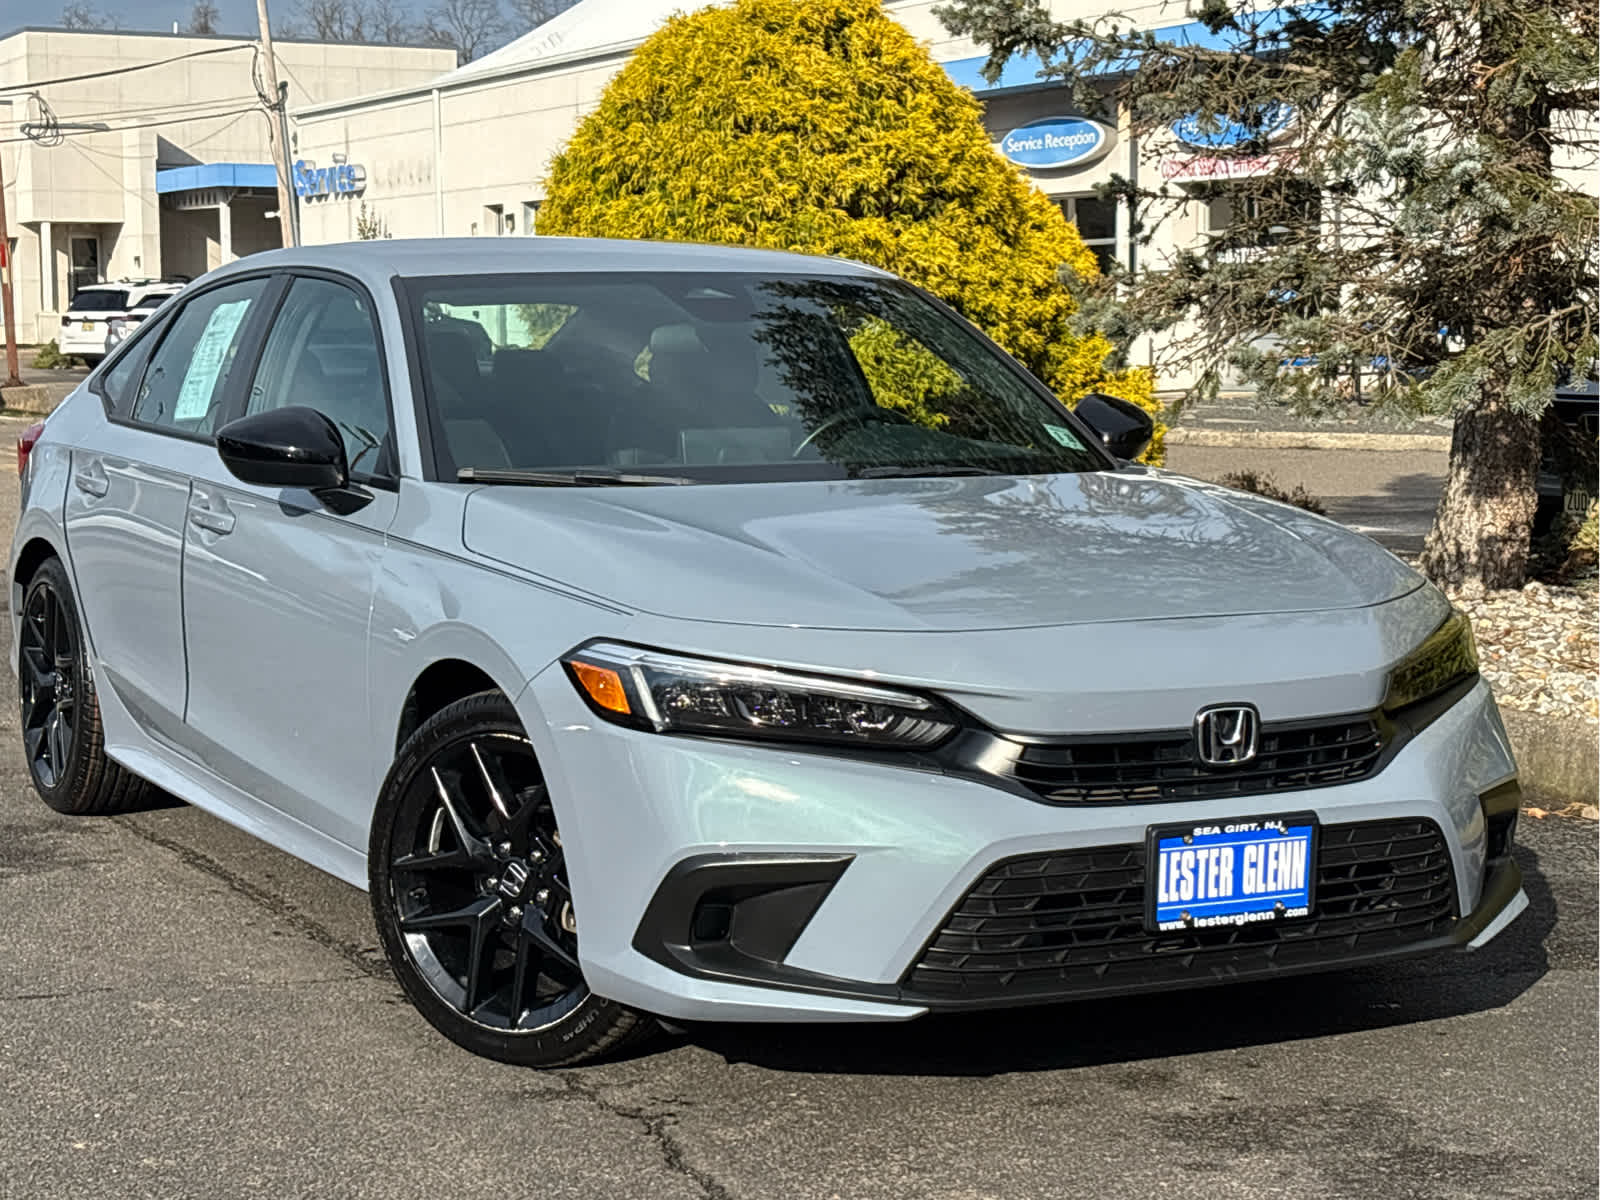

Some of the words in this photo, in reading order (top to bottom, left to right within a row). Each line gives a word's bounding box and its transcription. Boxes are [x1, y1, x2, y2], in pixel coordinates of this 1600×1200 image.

[1007, 136, 1043, 153] Service
[1045, 130, 1096, 150] Reception
[292, 157, 362, 199] Service
[1193, 826, 1221, 837] SEA
[1224, 823, 1261, 834] GIRT,
[1158, 847, 1235, 903] LESTER
[1242, 839, 1307, 895] GLENN
[1194, 911, 1275, 928] lesterglenn
